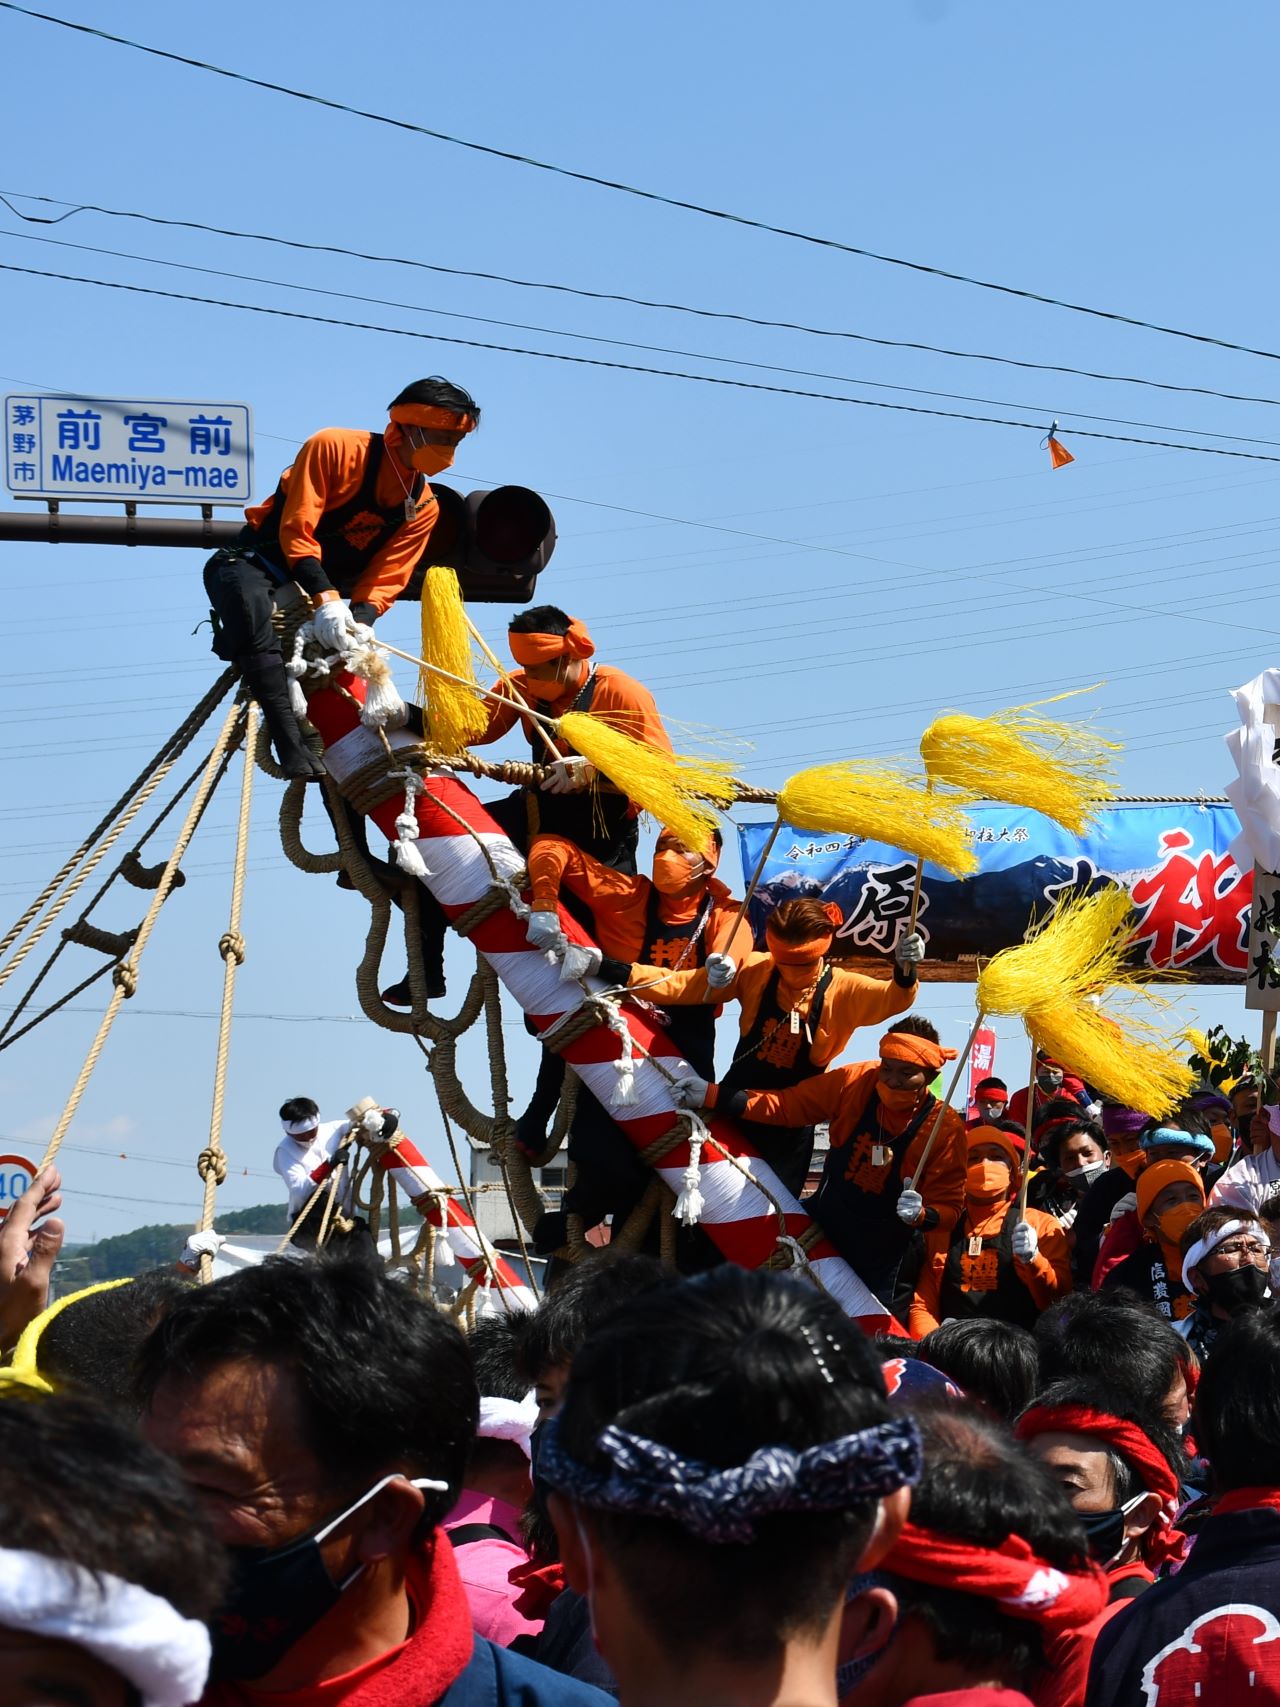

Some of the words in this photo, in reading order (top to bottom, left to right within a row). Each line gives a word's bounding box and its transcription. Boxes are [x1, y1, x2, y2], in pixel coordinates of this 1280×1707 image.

[11, 404, 37, 483] 茅野市
[56, 408, 233, 456] 前宮前
[51, 454, 239, 490] Maemiya-mae
[839, 861, 929, 952] 原
